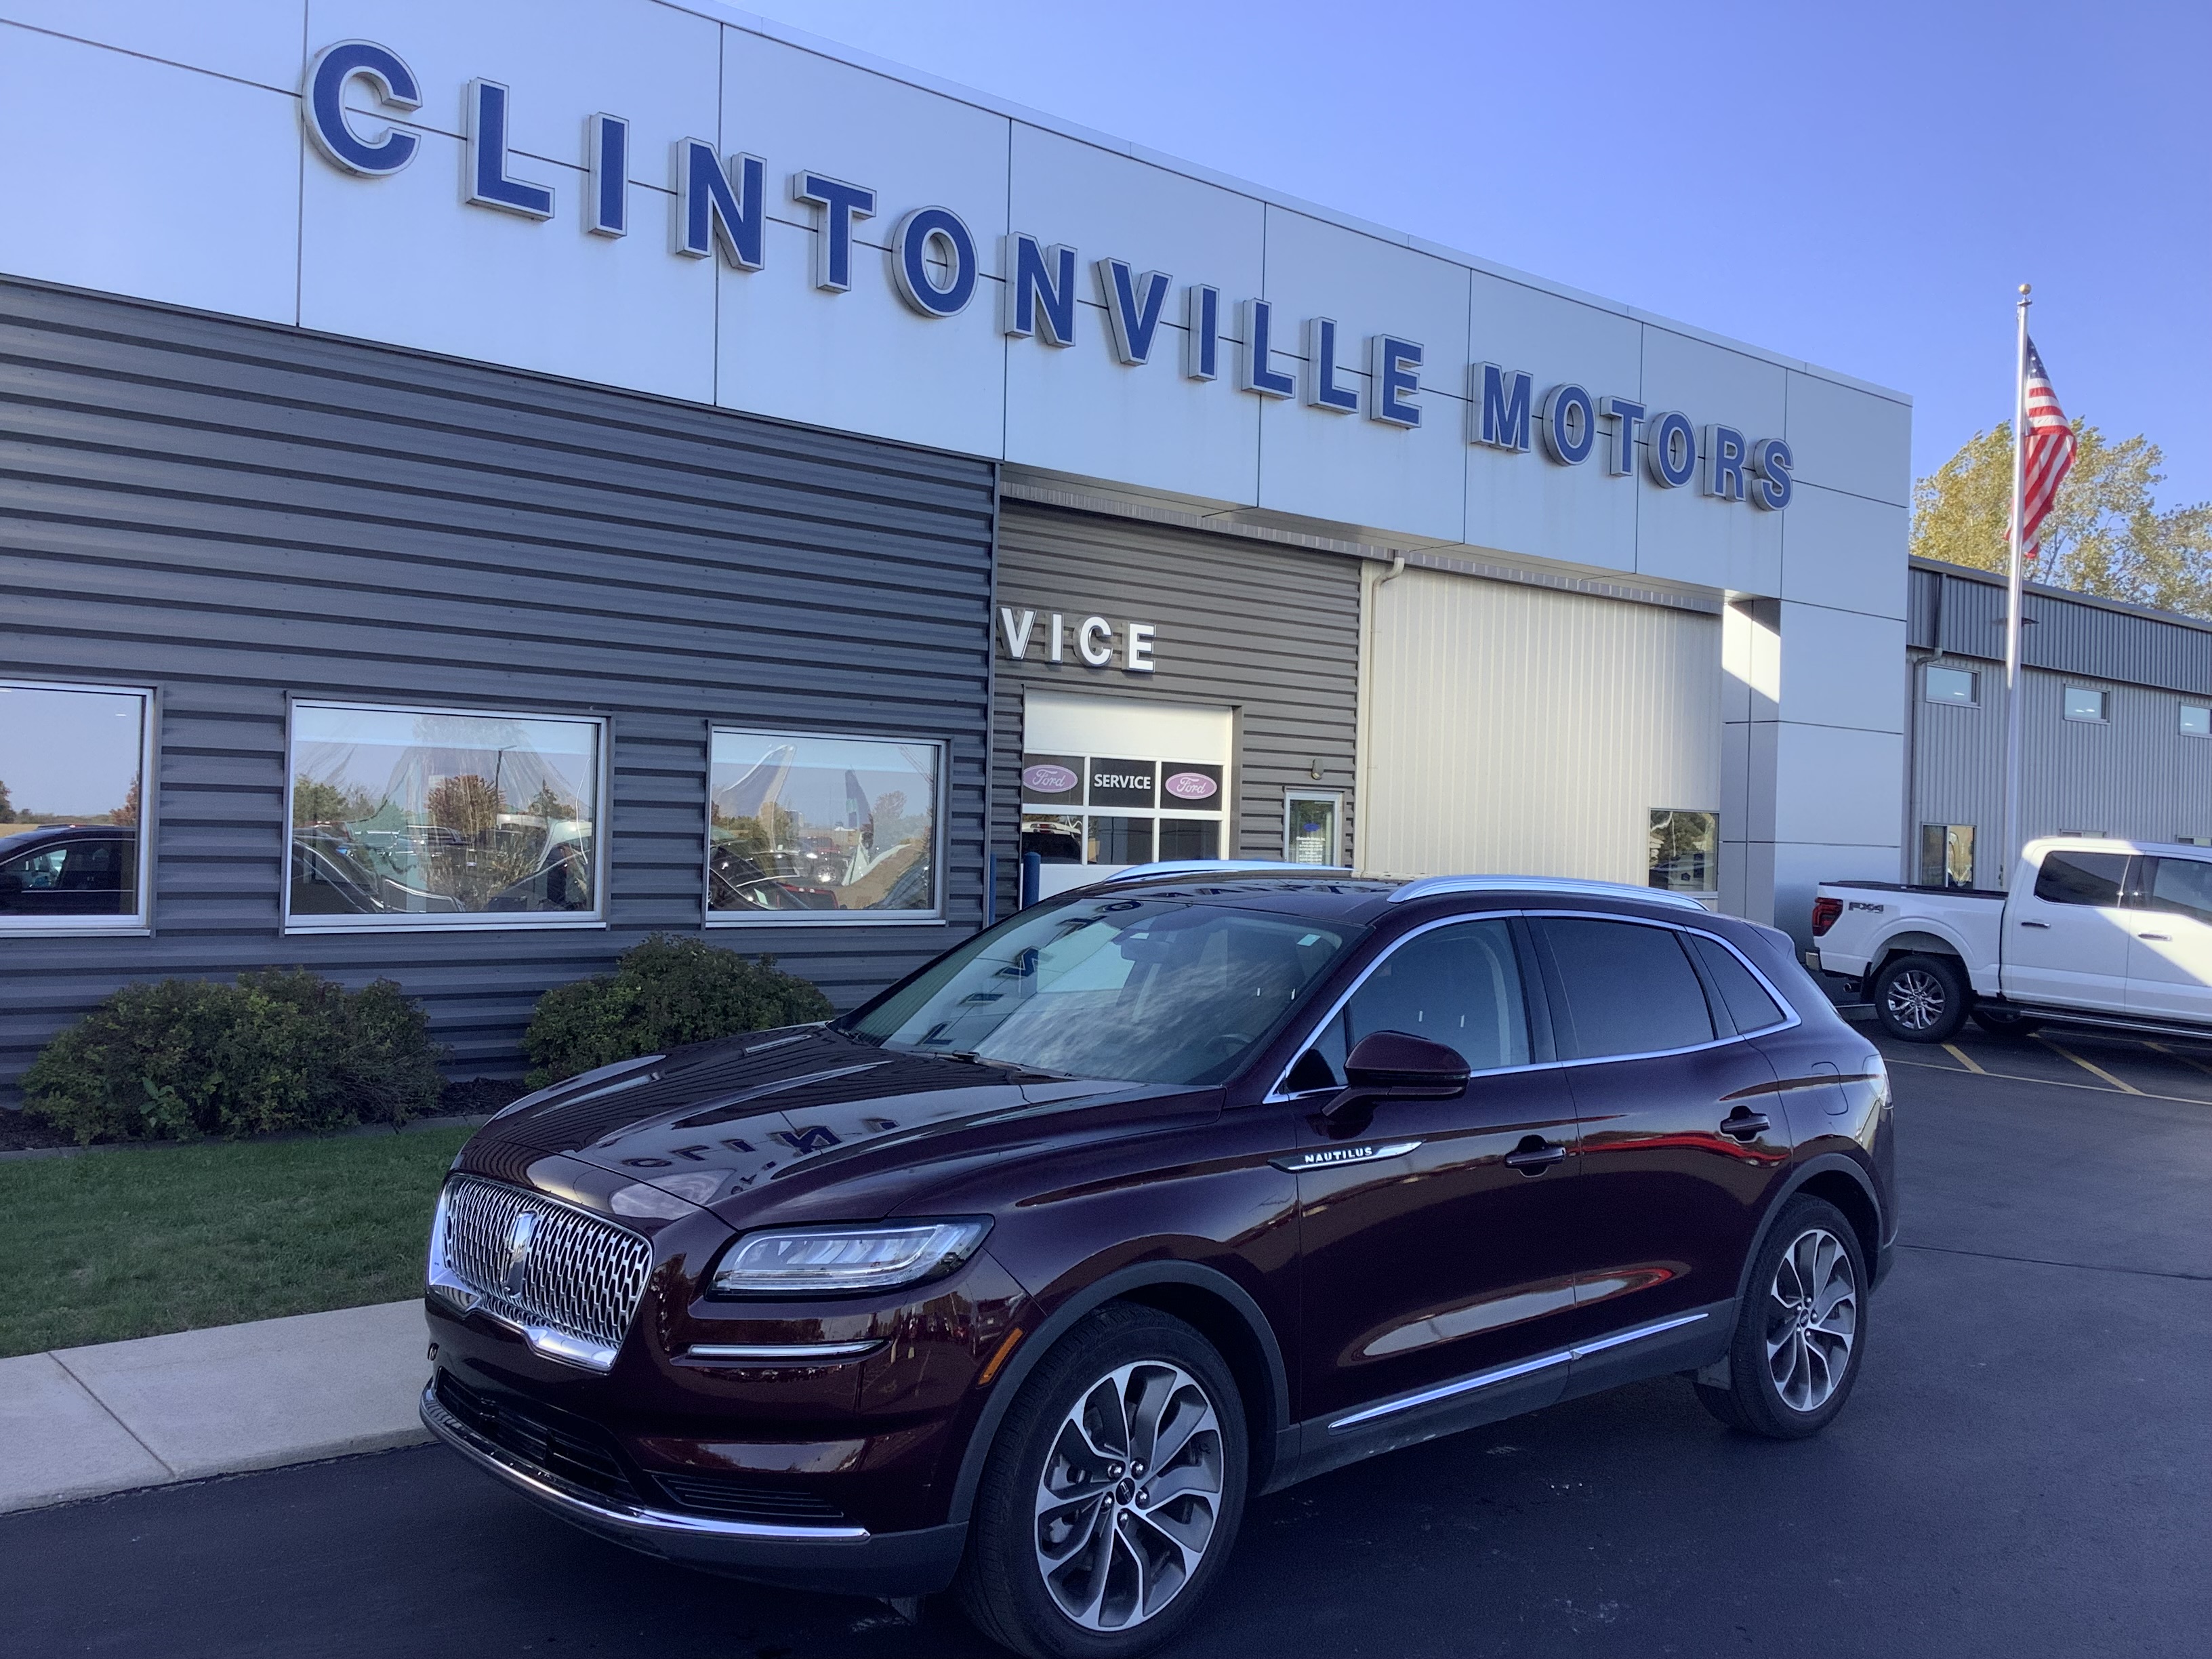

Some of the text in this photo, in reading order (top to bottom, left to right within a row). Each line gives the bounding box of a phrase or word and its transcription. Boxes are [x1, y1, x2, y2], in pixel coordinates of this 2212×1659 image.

[302, 39, 1794, 512] CLINTONVILLE MOTORS
[1032, 769, 1067, 787] Ford
[1094, 774, 1151, 790] SERVICE
[1176, 777, 1206, 794] Ford
[1848, 902, 1884, 912] FX4
[1304, 1147, 1372, 1164] NAUTILUS
